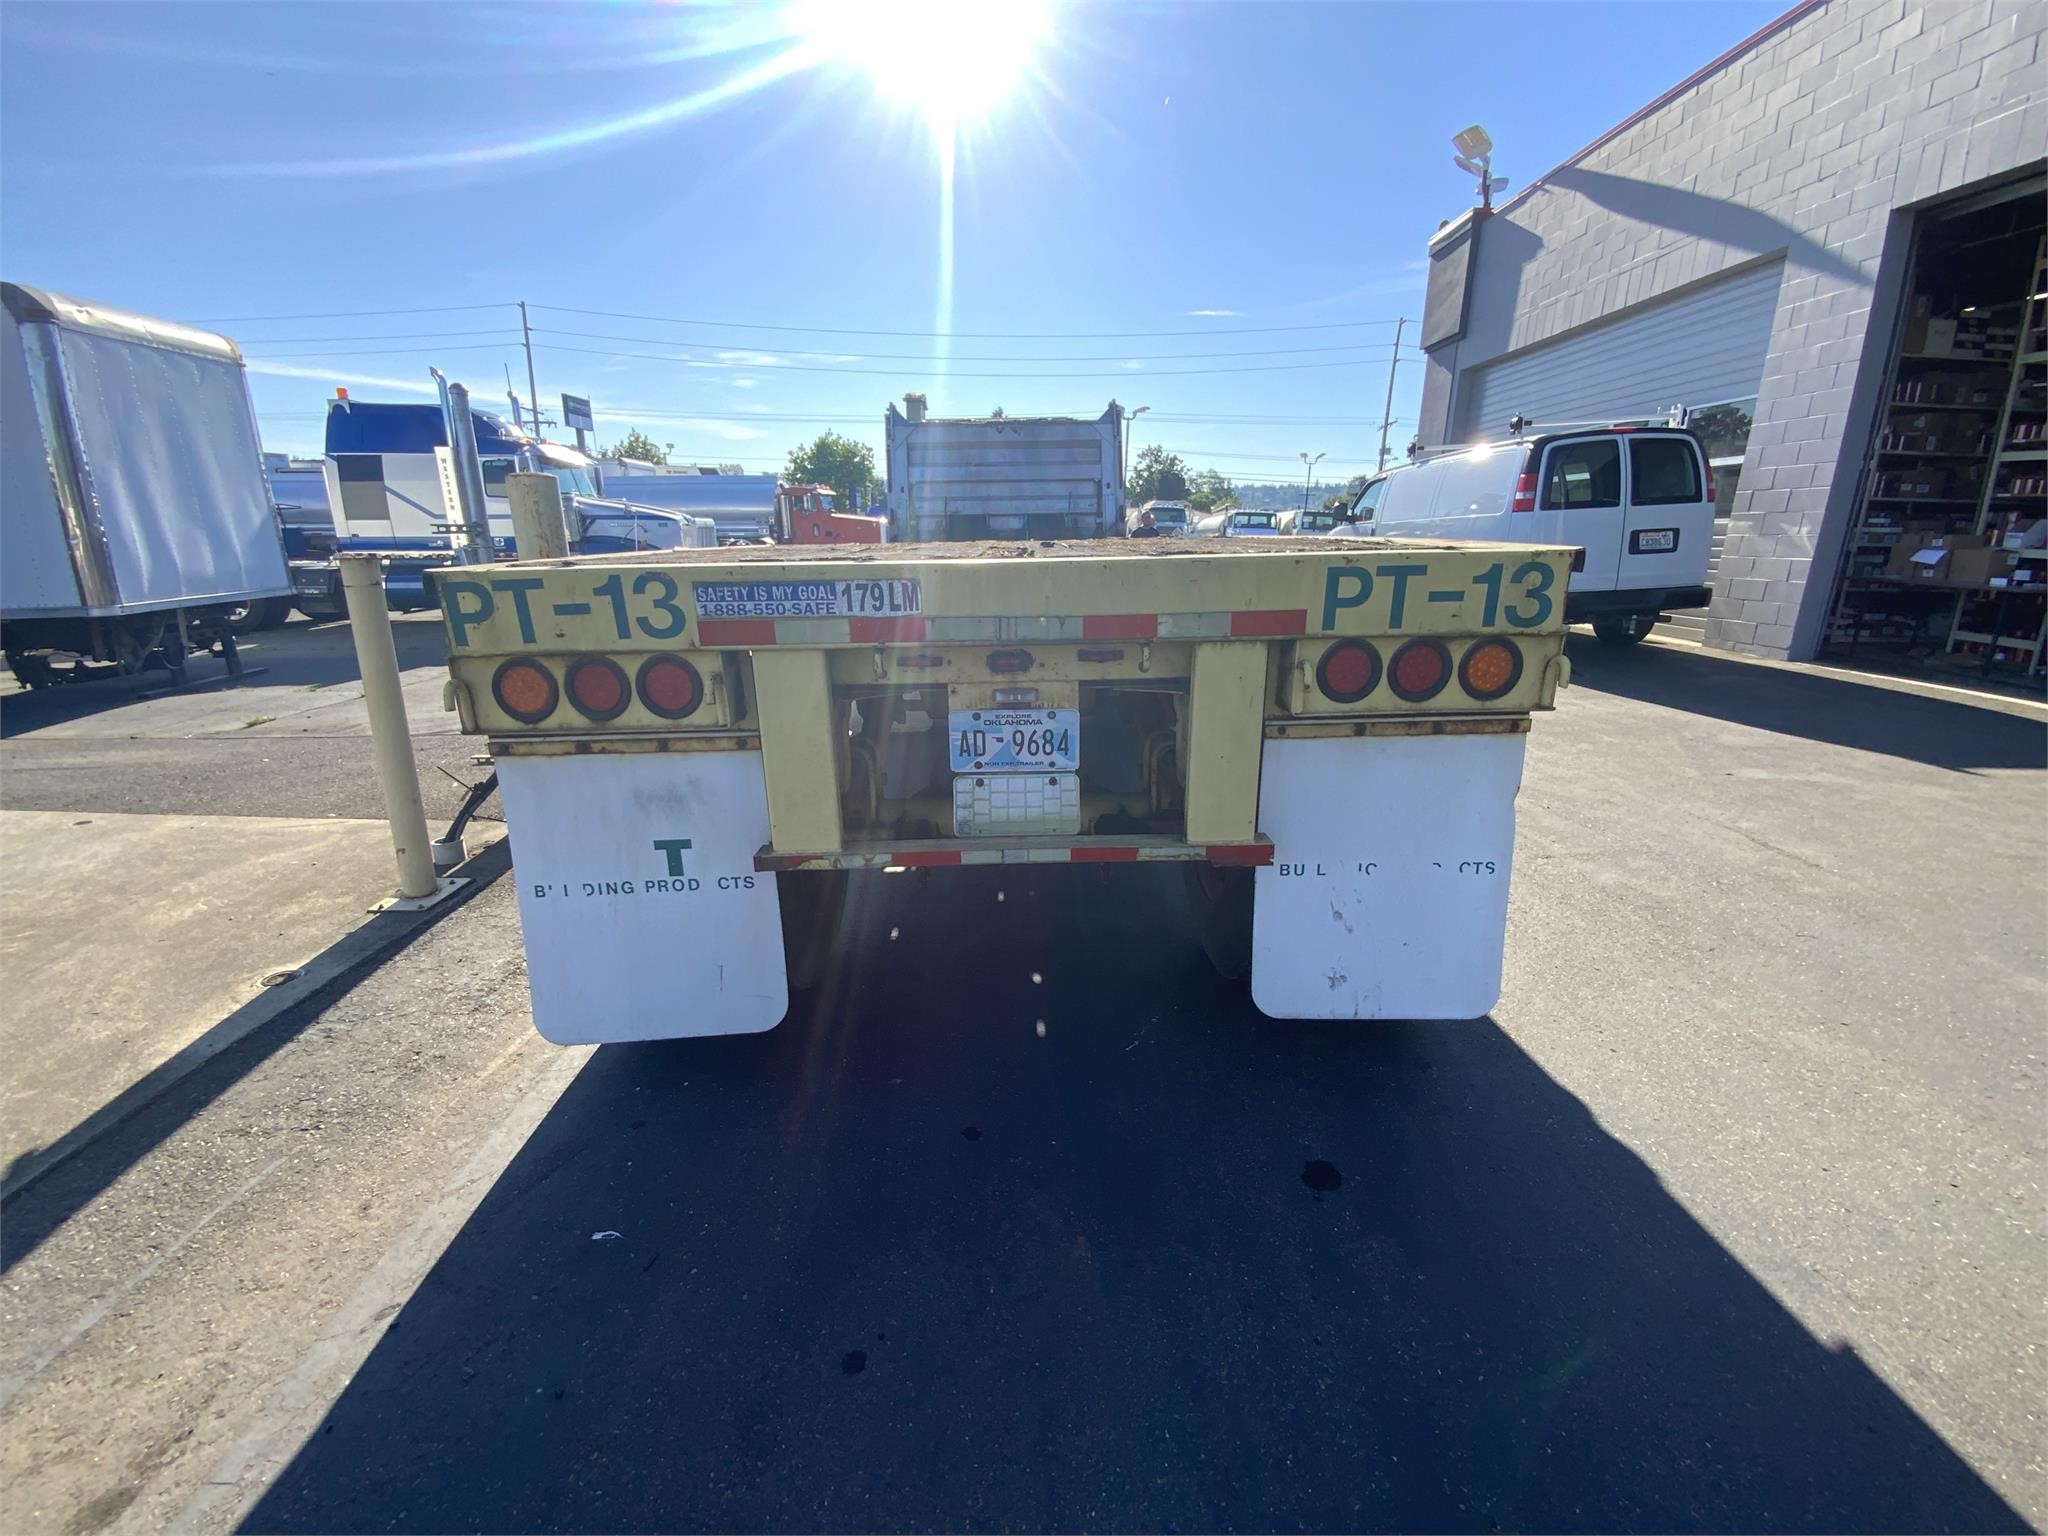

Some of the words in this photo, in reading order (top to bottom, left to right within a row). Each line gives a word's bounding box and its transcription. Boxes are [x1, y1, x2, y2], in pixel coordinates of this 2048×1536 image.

[698, 586, 749, 601] SAFETY
[754, 586, 768, 600] IS
[772, 586, 794, 600] MY
[798, 585, 835, 600] GOAL
[1320, 560, 1556, 632] PT-13
[440, 571, 687, 648] PT-13
[699, 601, 837, 617] 1-888-550-SAFE
[959, 730, 986, 757] AD
[1012, 728, 1070, 757] 9684
[534, 880, 635, 898] BIDING
[645, 875, 755, 894] PRODCTS
